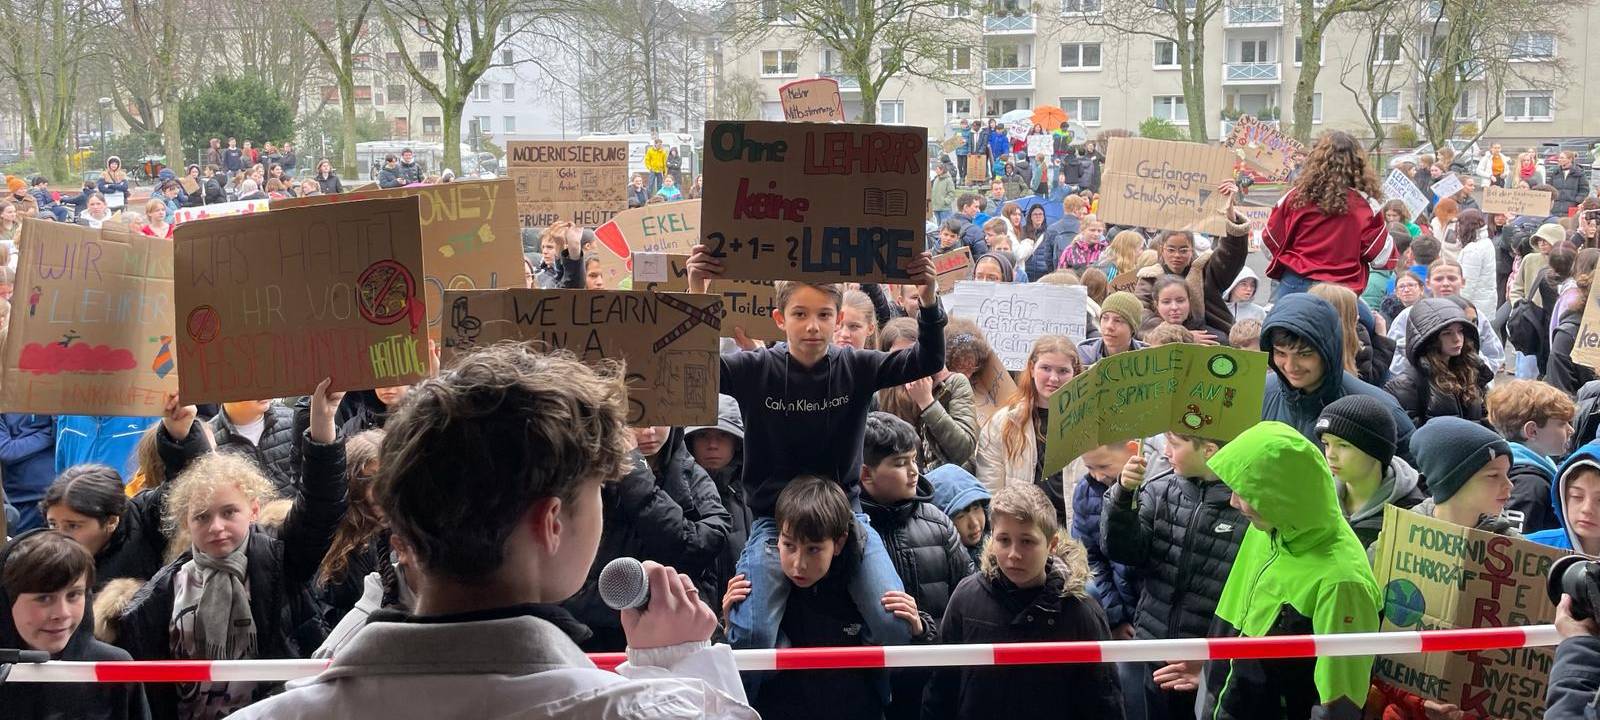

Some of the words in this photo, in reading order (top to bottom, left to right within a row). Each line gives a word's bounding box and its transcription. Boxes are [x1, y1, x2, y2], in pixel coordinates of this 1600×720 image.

[513, 145, 626, 163] MODERNISIERUNG
[711, 123, 788, 162] Ohne
[803, 131, 923, 175] LEHRER
[1136, 159, 1208, 191] Gefangen
[1162, 180, 1177, 190] im
[733, 177, 809, 223] keine
[641, 213, 695, 237] EKEL
[37, 241, 104, 282] WIR
[190, 231, 250, 288] WAS
[278, 210, 403, 281] HALTET
[643, 238, 679, 252] wollen
[802, 226, 914, 280] LEHRE
[229, 285, 287, 328] IHR
[513, 296, 561, 326] WE
[572, 294, 658, 328] LEARN
[583, 328, 605, 360] A
[1058, 375, 1089, 414] DIE
[1095, 349, 1184, 387] SCHULE
[796, 400, 820, 412] Klein
